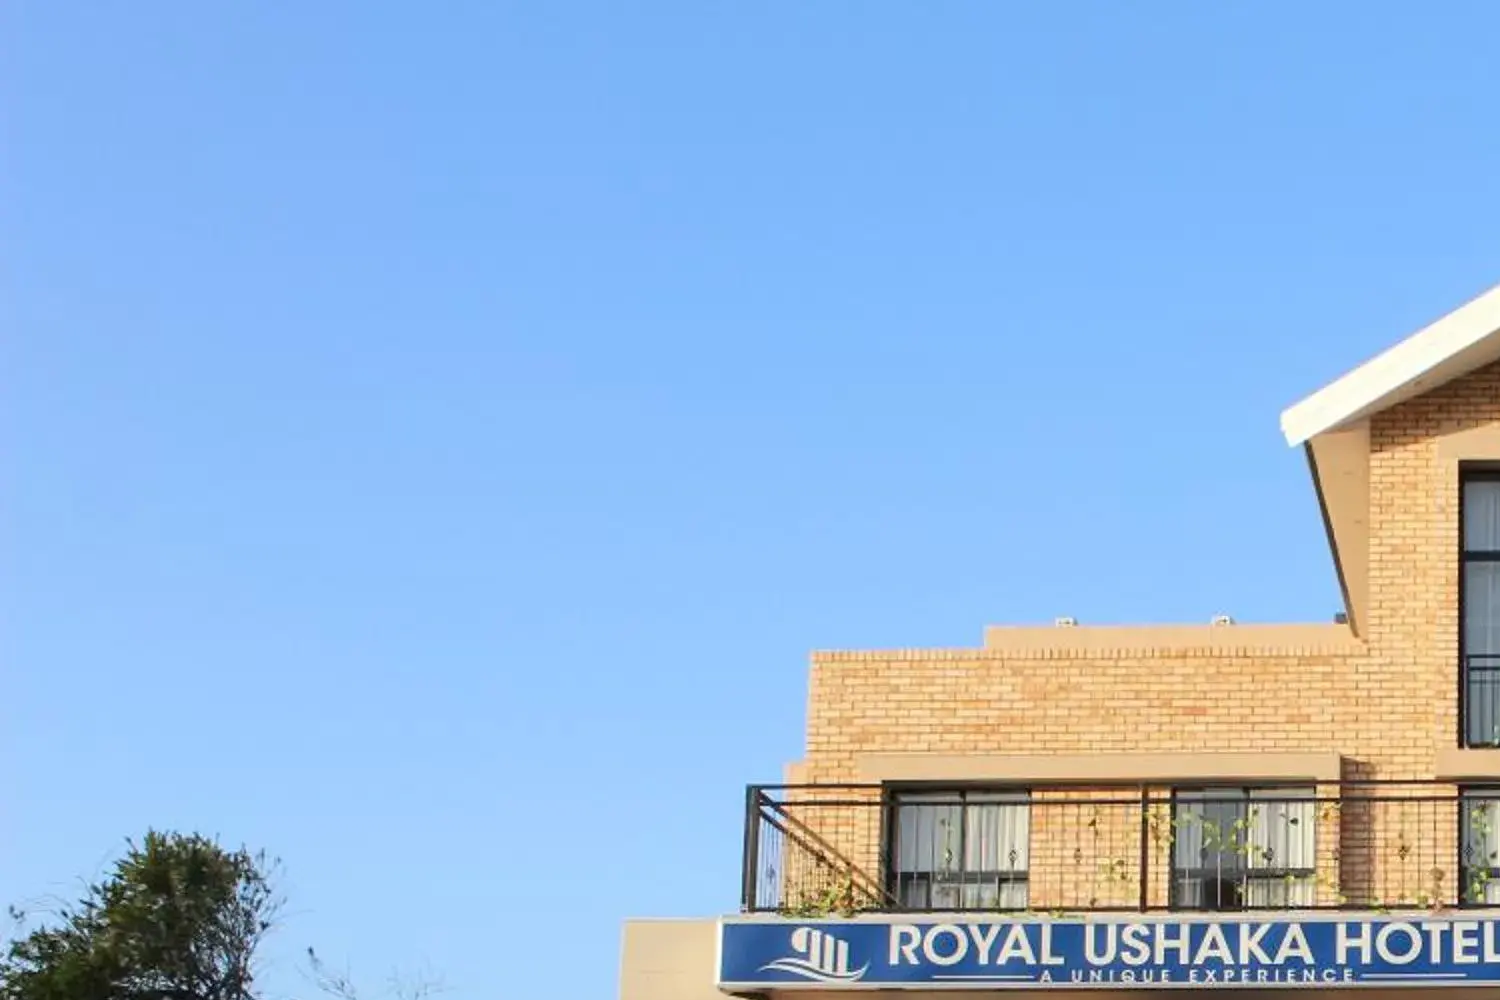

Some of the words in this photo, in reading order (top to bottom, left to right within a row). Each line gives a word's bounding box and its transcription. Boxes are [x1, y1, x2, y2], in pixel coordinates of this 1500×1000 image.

[888, 923, 1065, 966] ROYAL
[1084, 922, 1315, 966] USHAKA
[1039, 969, 1052, 983] A
[1071, 969, 1170, 983] UNIQUE
[1188, 968, 1354, 983] EXPERIENCE
